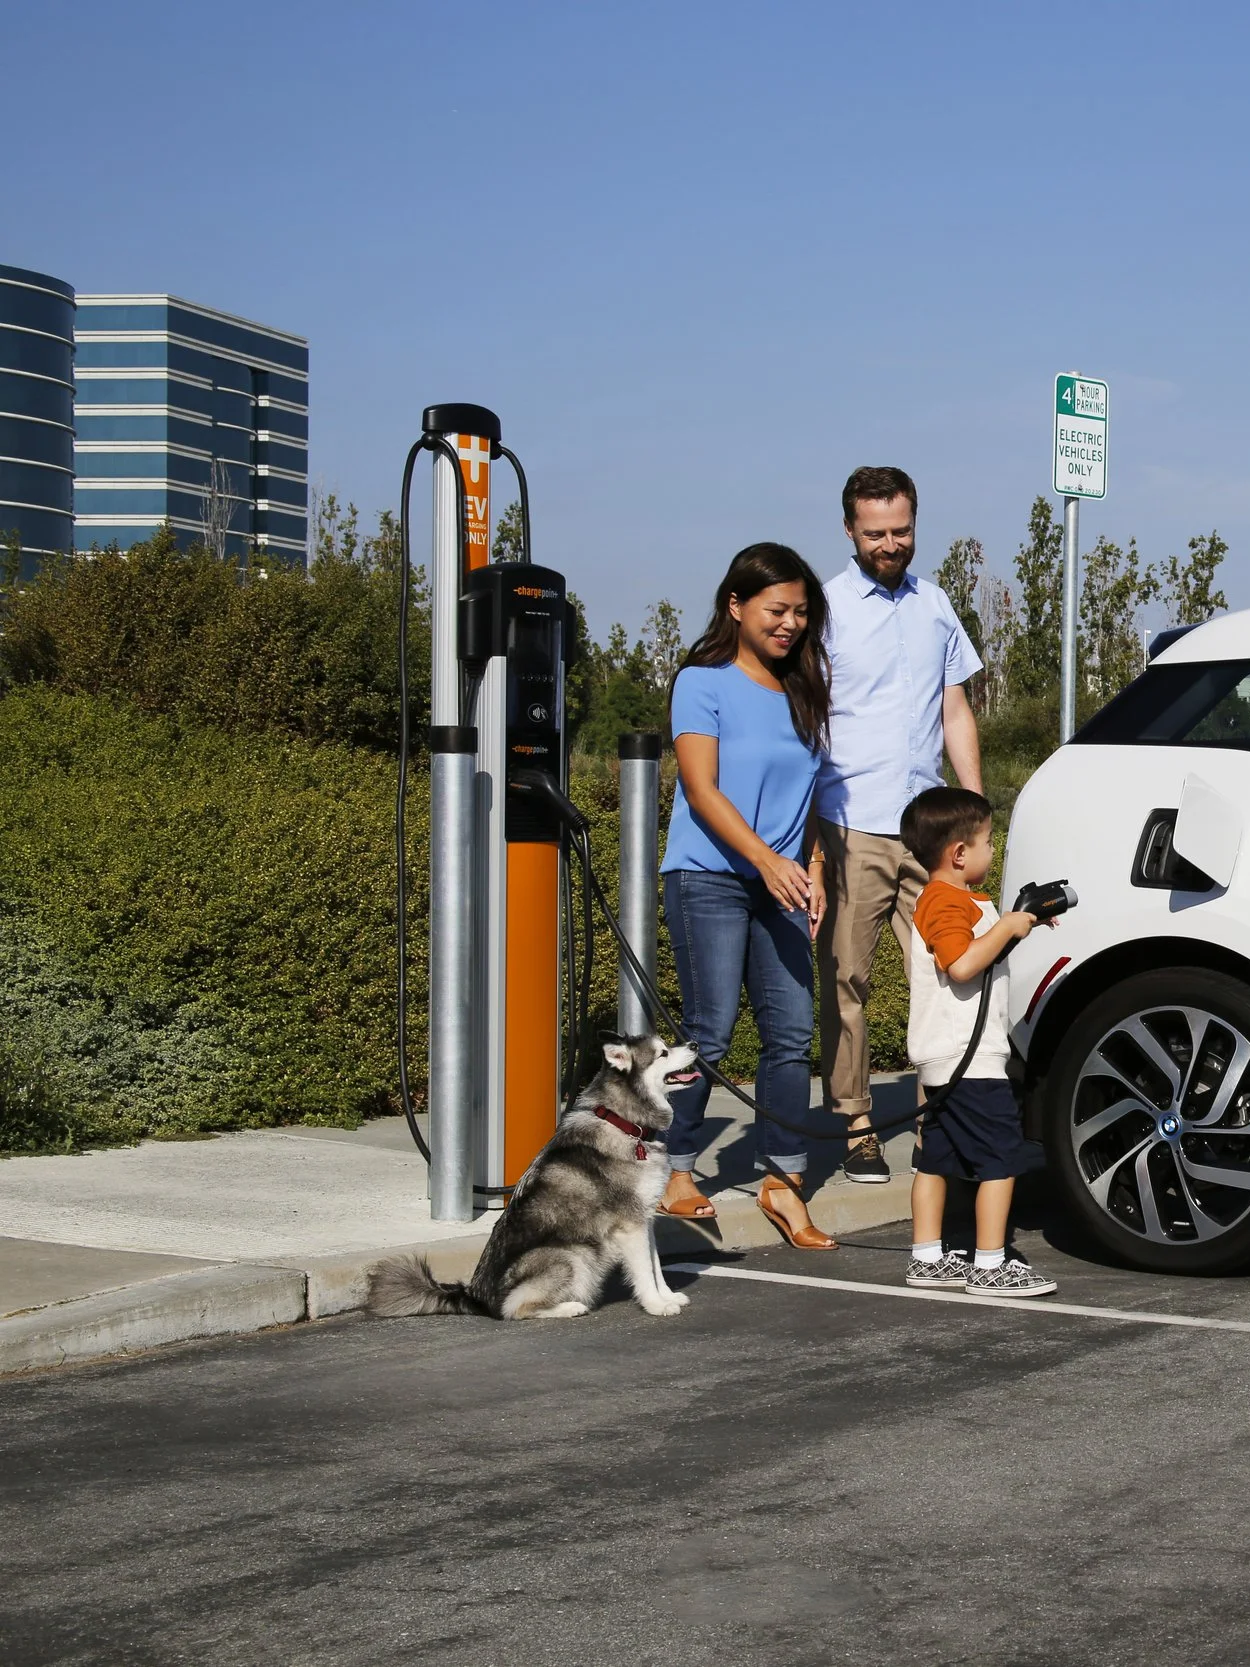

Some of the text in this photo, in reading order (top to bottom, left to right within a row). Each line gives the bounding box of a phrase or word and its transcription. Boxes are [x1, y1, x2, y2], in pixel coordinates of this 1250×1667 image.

[1062, 387, 1072, 404] 4
[1081, 386, 1100, 400] HOUR
[1076, 398, 1105, 415] PARKING
[1059, 428, 1103, 446] ELECTRIC
[1059, 445, 1103, 462] VEHICLES
[1068, 462, 1093, 477] ONLY
[464, 495, 487, 520] EV
